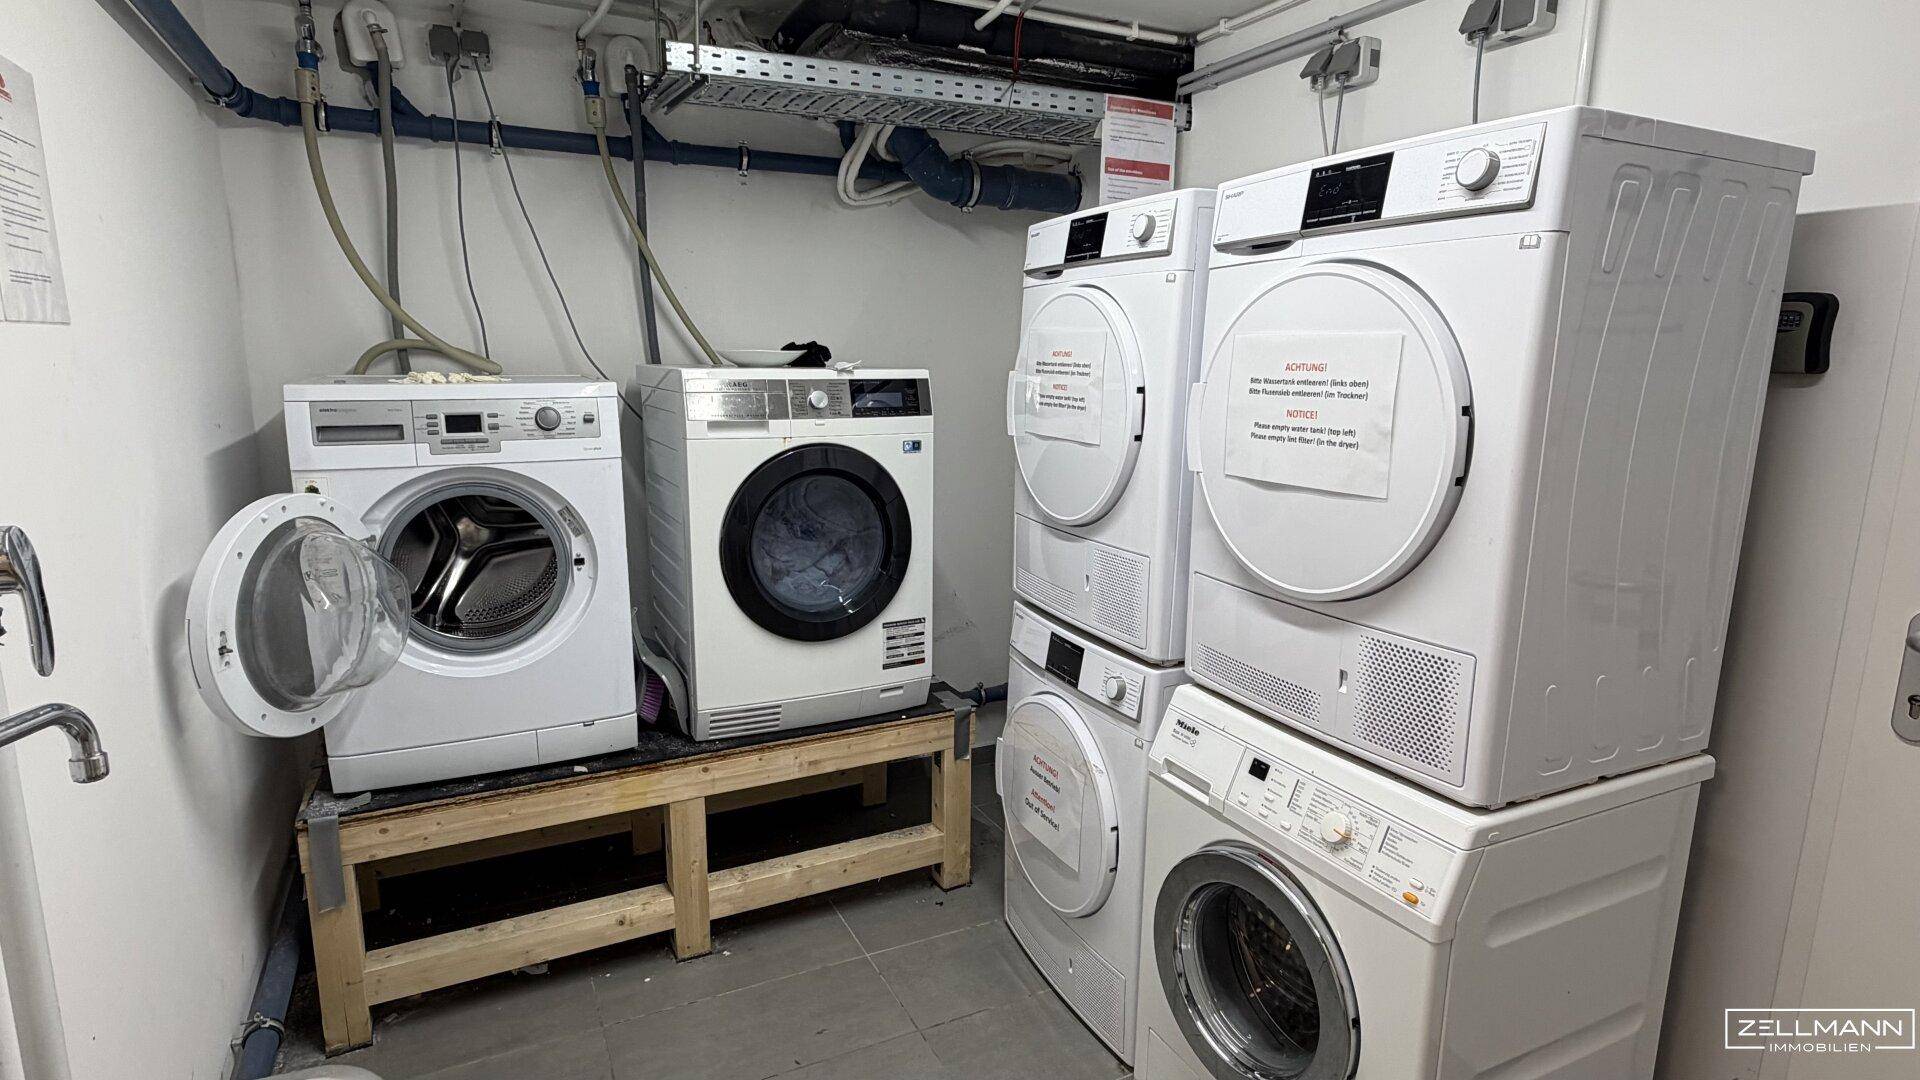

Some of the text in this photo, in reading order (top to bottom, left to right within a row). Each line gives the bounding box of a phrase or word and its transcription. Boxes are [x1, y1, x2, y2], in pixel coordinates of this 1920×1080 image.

[1285, 362, 1328, 372] ACHTUNG!
[1330, 380, 1348, 388] (links
[1349, 380, 1369, 389] oben)
[1262, 388, 1290, 397] Flusensieb
[1324, 391, 1336, 399] (im
[1337, 392, 1368, 401] Trockner)
[1286, 409, 1318, 420] NOTICE!
[1254, 422, 1270, 430] Please
[1271, 424, 1290, 433] empty
[1327, 427, 1341, 437] (top
[1342, 428, 1356, 438] left)
[1251, 432, 1359, 450] Please empty lint filter! (in the dryer)
[1176, 719, 1200, 736] Miele
[1032, 754, 1059, 780] ACHTUNG!
[1031, 788, 1055, 813] Attention!
[1025, 797, 1060, 832] Out of Service!
